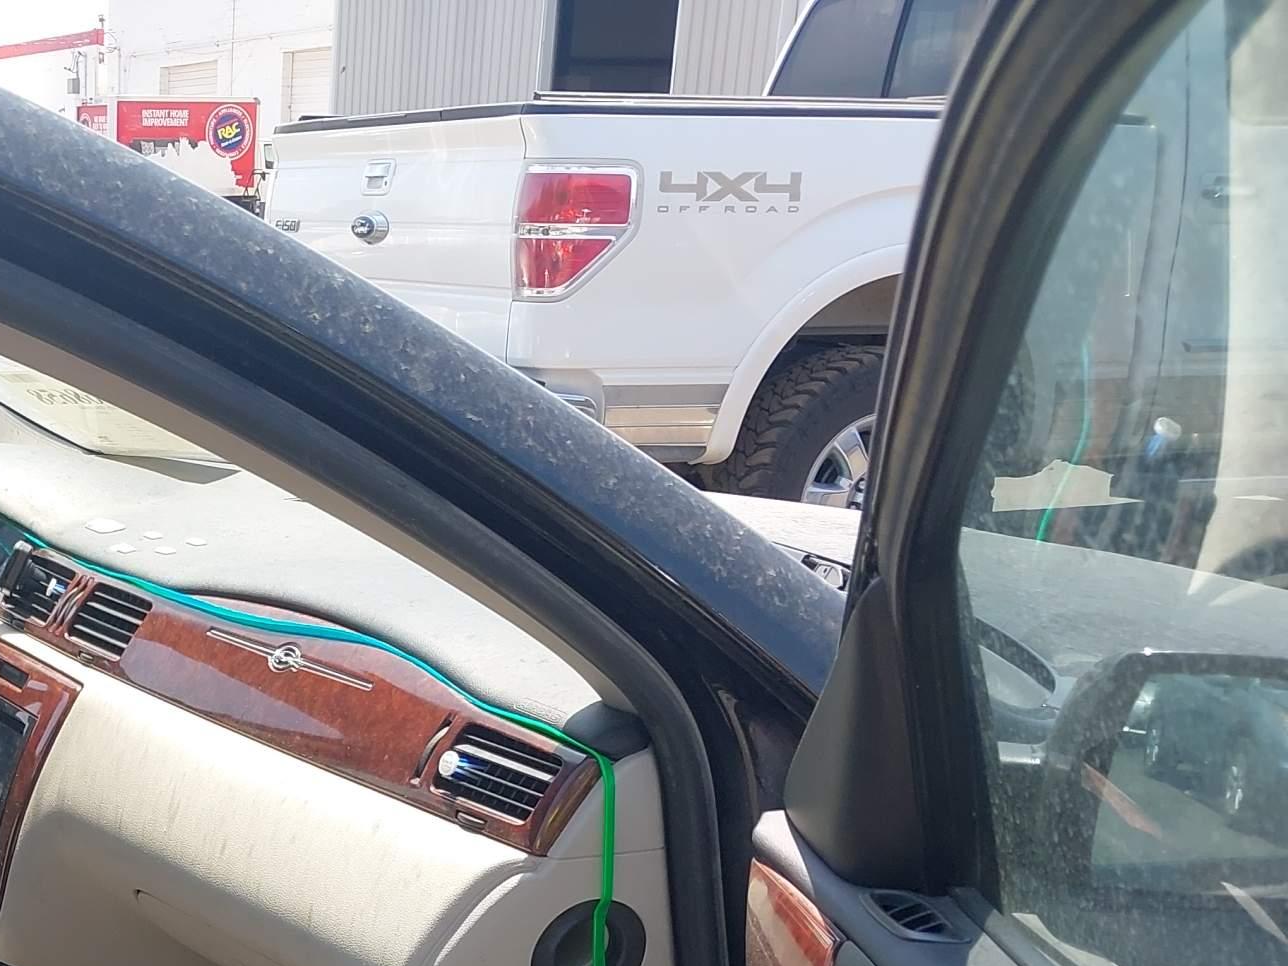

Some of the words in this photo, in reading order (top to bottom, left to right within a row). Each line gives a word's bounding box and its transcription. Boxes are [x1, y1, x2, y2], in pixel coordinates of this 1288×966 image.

[142, 109, 168, 118] INSTANT
[170, 109, 190, 118] HOME
[142, 118, 189, 127] IMPROVEMENT
[723, 205, 801, 214] ROAD
